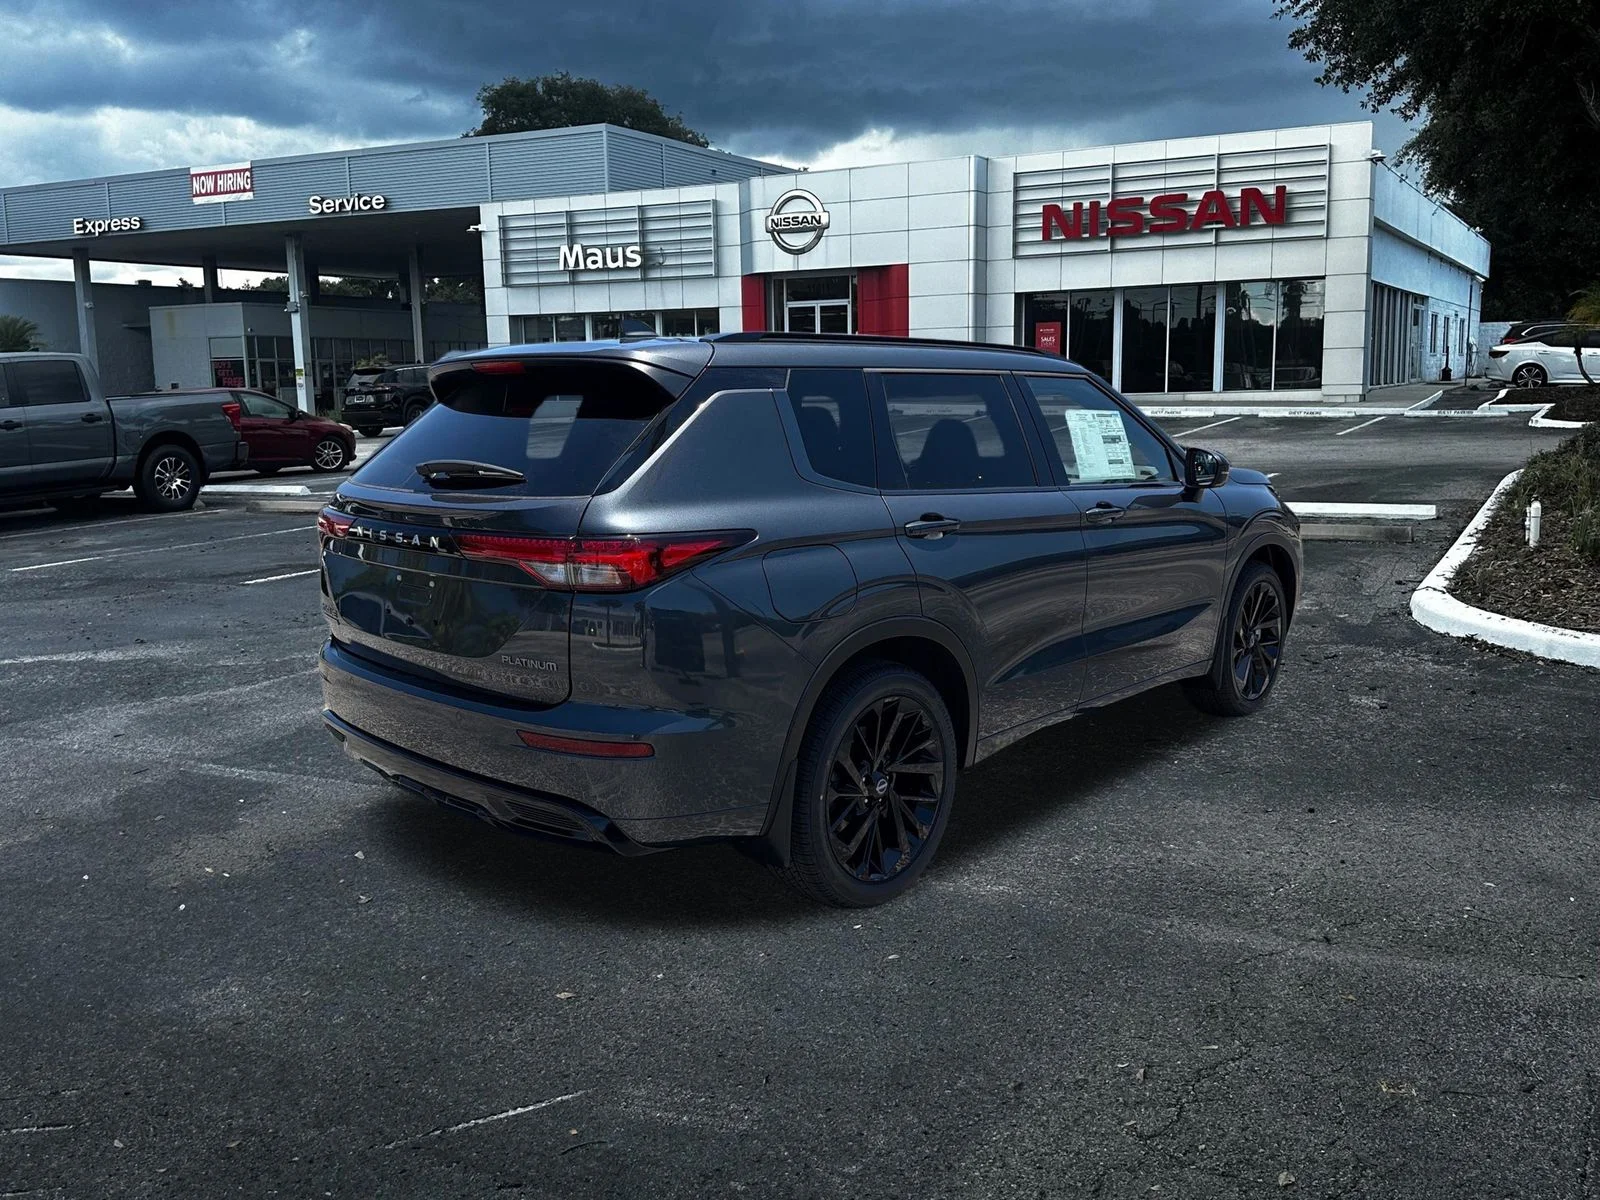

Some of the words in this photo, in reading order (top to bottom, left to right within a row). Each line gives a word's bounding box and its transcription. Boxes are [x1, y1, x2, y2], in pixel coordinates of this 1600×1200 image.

[192, 176, 215, 195] NOW
[217, 171, 251, 192] HIRING
[309, 193, 386, 215] Service
[1042, 185, 1287, 241] NISSAN
[72, 216, 141, 237] Express
[769, 214, 822, 229] NISSAN
[559, 243, 642, 270] Maus
[356, 526, 440, 548] NISSAN
[501, 655, 557, 671] PLATINUM
